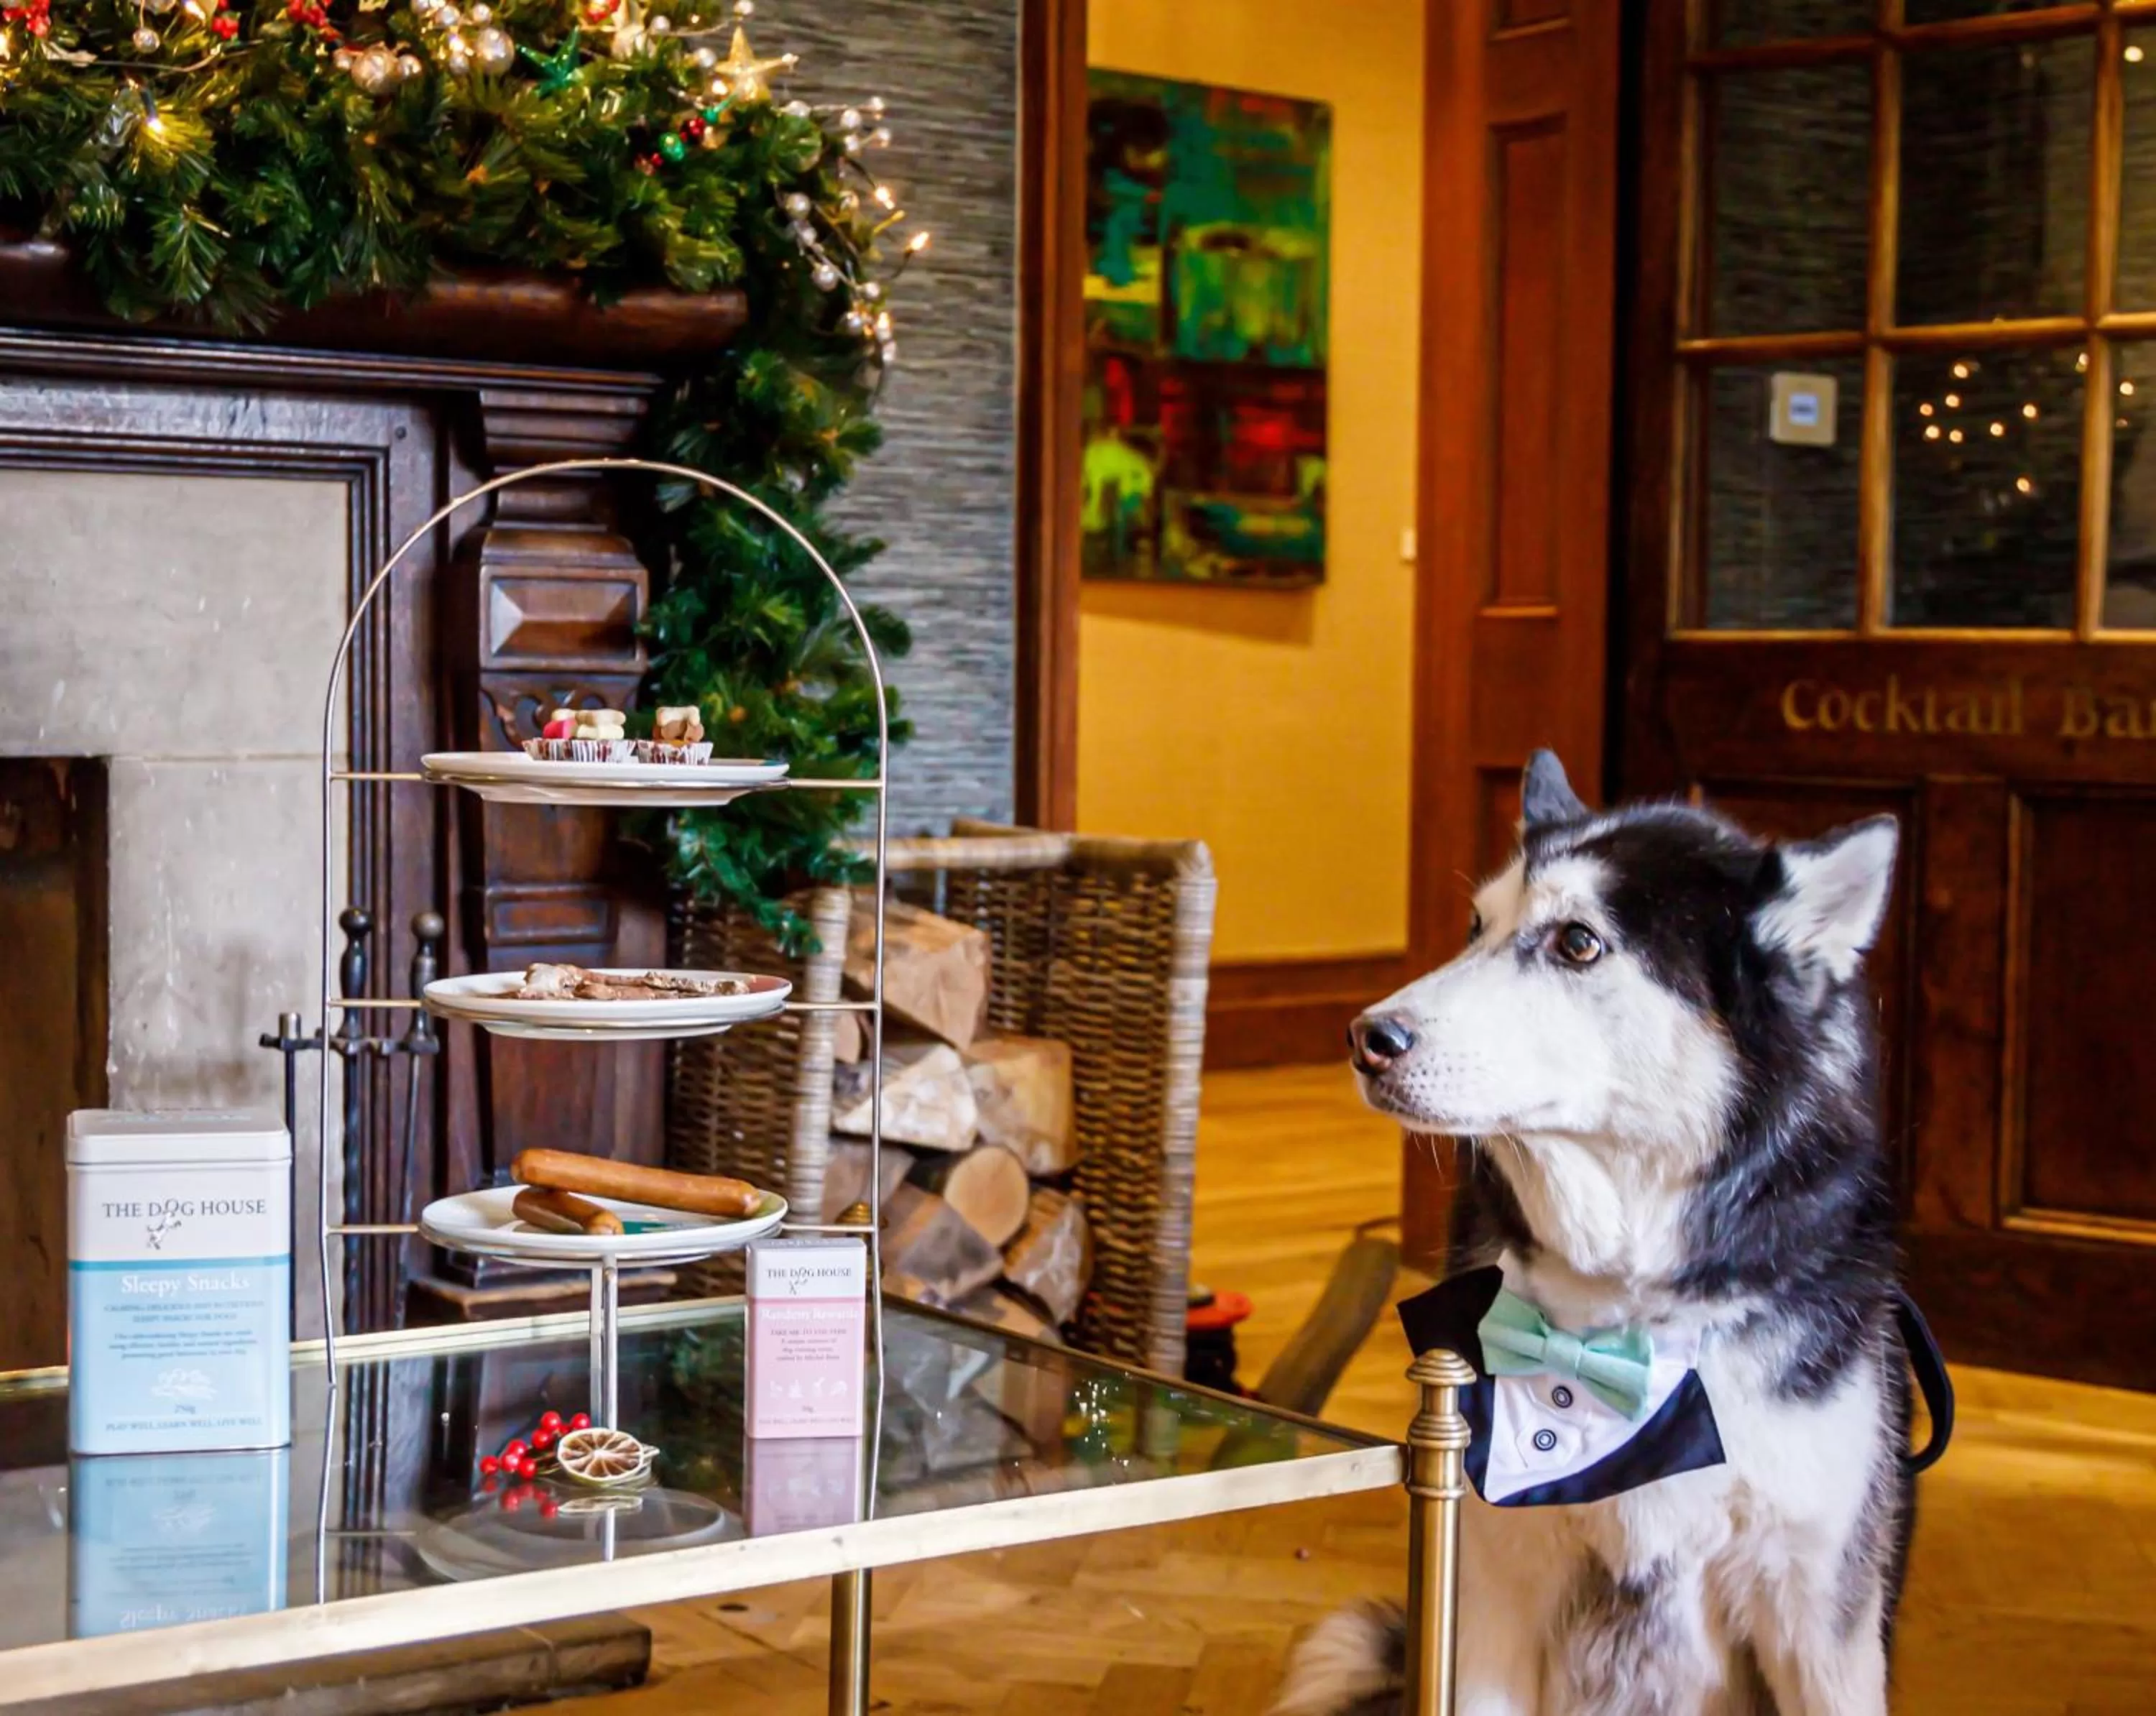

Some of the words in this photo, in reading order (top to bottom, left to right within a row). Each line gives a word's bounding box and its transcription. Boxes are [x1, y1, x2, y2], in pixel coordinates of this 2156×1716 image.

[1780, 673, 2024, 734] Cocktail
[101, 1201, 142, 1218] THE
[148, 1198, 195, 1217] DOG
[201, 1199, 267, 1215] HOUSE
[767, 1268, 787, 1278] THE
[790, 1267, 814, 1278] DOG
[816, 1268, 852, 1278] HOUSE
[121, 1274, 180, 1298] Sleepy
[187, 1271, 250, 1291] Snacks
